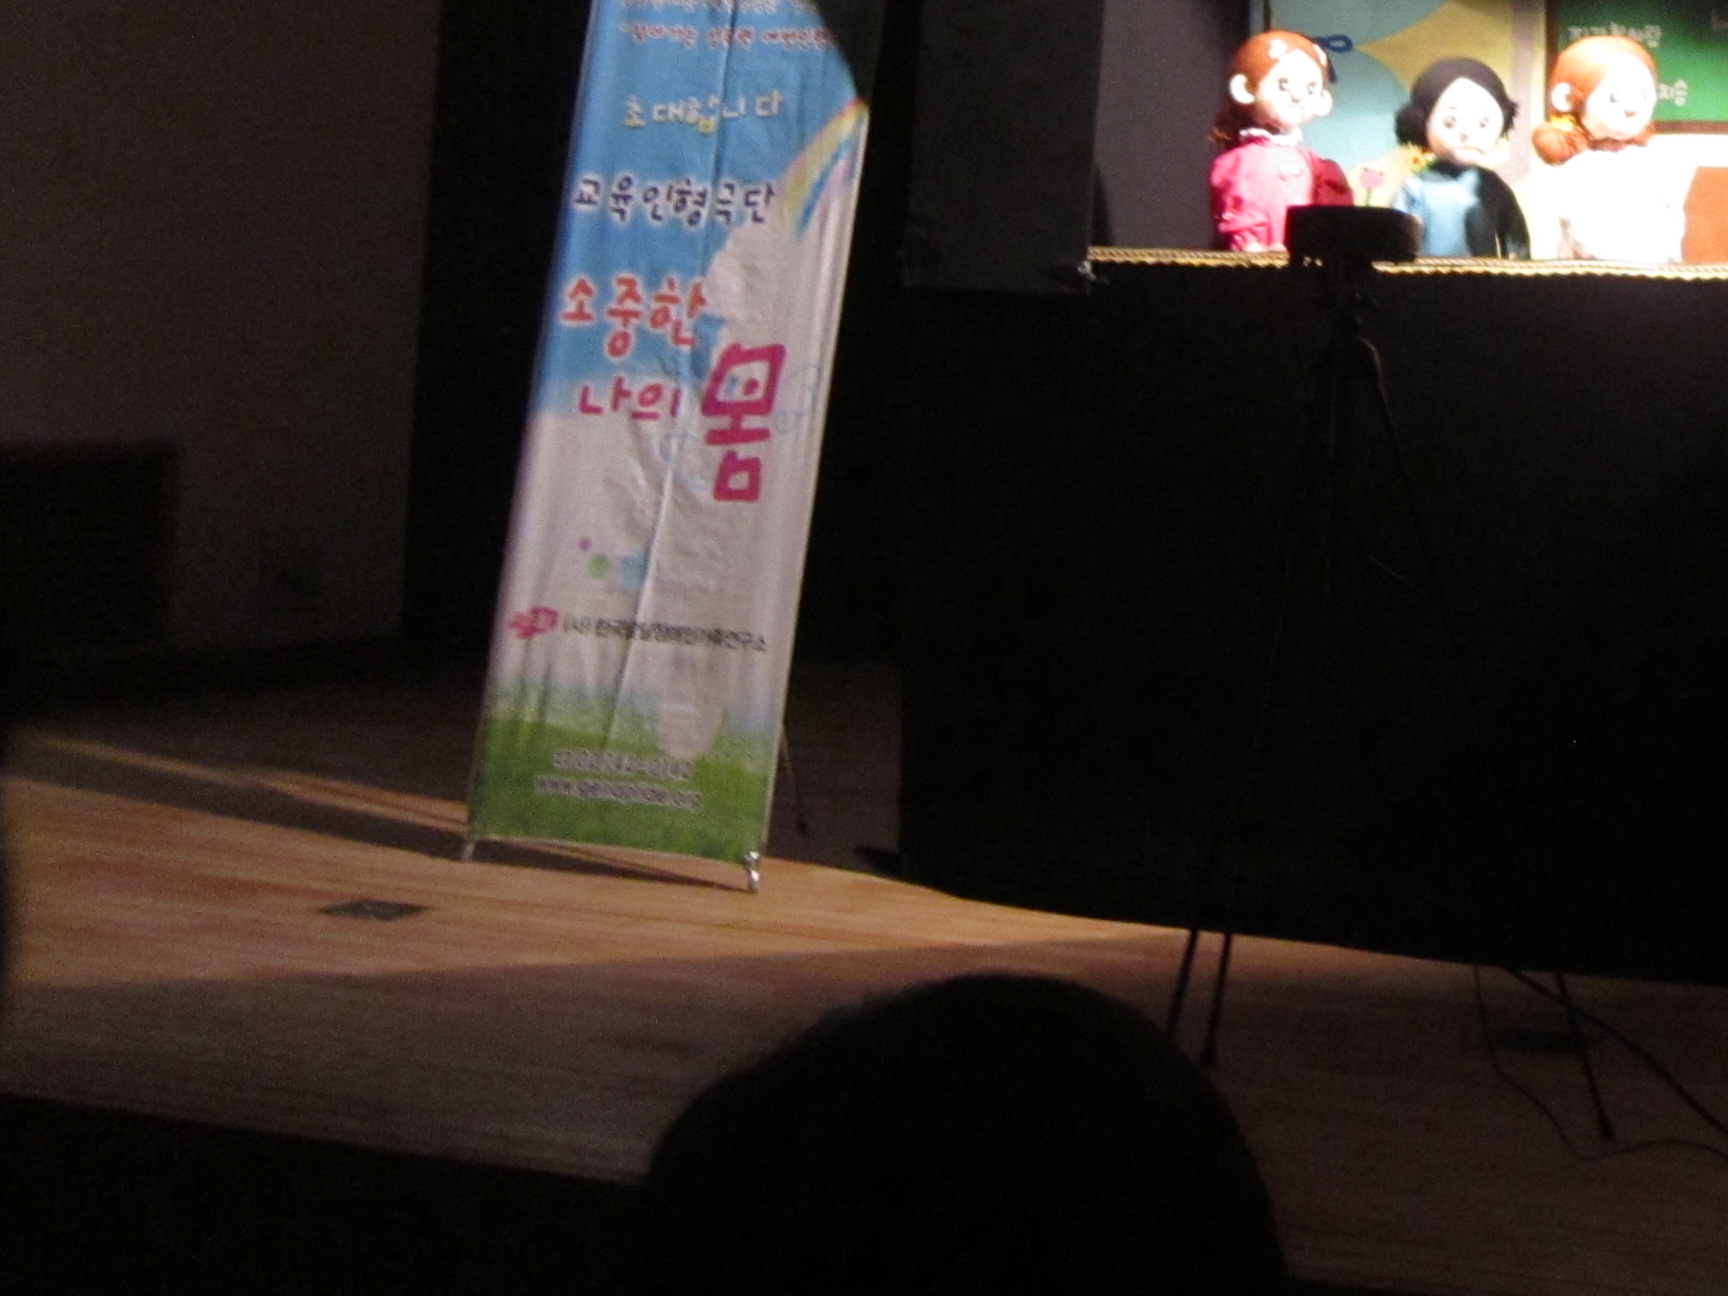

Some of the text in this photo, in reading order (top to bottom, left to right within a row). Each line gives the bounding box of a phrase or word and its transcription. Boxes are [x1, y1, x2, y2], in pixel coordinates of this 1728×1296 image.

[575, 174, 775, 228] 교육인형극단
[560, 277, 707, 359] 소중한
[579, 342, 787, 503] 나의 몸
